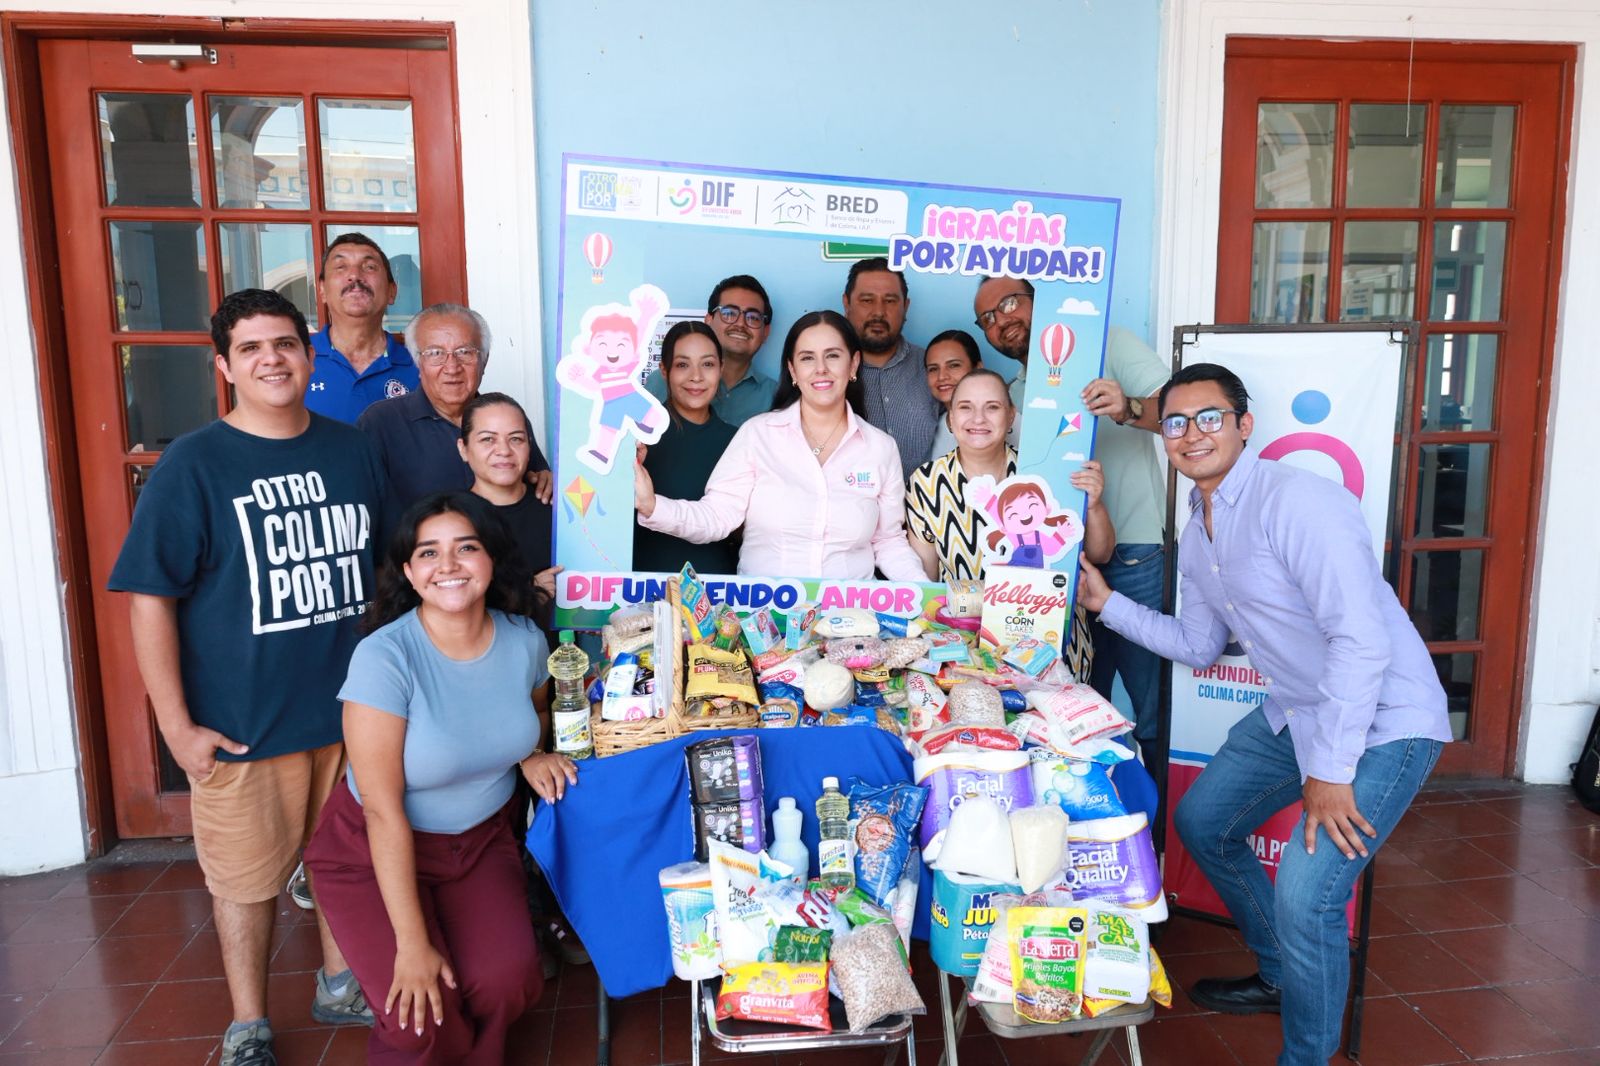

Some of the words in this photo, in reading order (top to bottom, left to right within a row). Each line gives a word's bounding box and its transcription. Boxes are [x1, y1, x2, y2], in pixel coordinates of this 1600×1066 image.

[586, 192, 612, 206] POR
[702, 180, 735, 207] DIF
[826, 194, 879, 214] BRED
[893, 239, 954, 270] POR
[965, 244, 1101, 279] AYUDAR!
[857, 472, 871, 483] DIF
[251, 471, 327, 510] OTRO
[263, 503, 371, 566] COLIMA
[269, 561, 335, 619] POR
[336, 555, 364, 604] TI
[567, 575, 798, 609] DIFUNENDO
[821, 585, 916, 613] AMOR
[983, 581, 1067, 615] Kellogg's
[313, 610, 337, 625] COLIMA
[1005, 616, 1035, 626] CORN
[1005, 625, 1034, 633] FLAKES
[1193, 664, 1266, 686] DIFUNDIE
[1198, 684, 1234, 702] COLIMA
[957, 774, 1003, 794] Facial
[1069, 843, 1118, 867] Facial
[1063, 863, 1129, 889] Quality
[963, 929, 991, 940] Péta
[1024, 962, 1050, 973] Frijoles
[1052, 964, 1076, 974] Bayos
[1035, 972, 1064, 982] Refritos
[740, 995, 794, 1015] granvita
